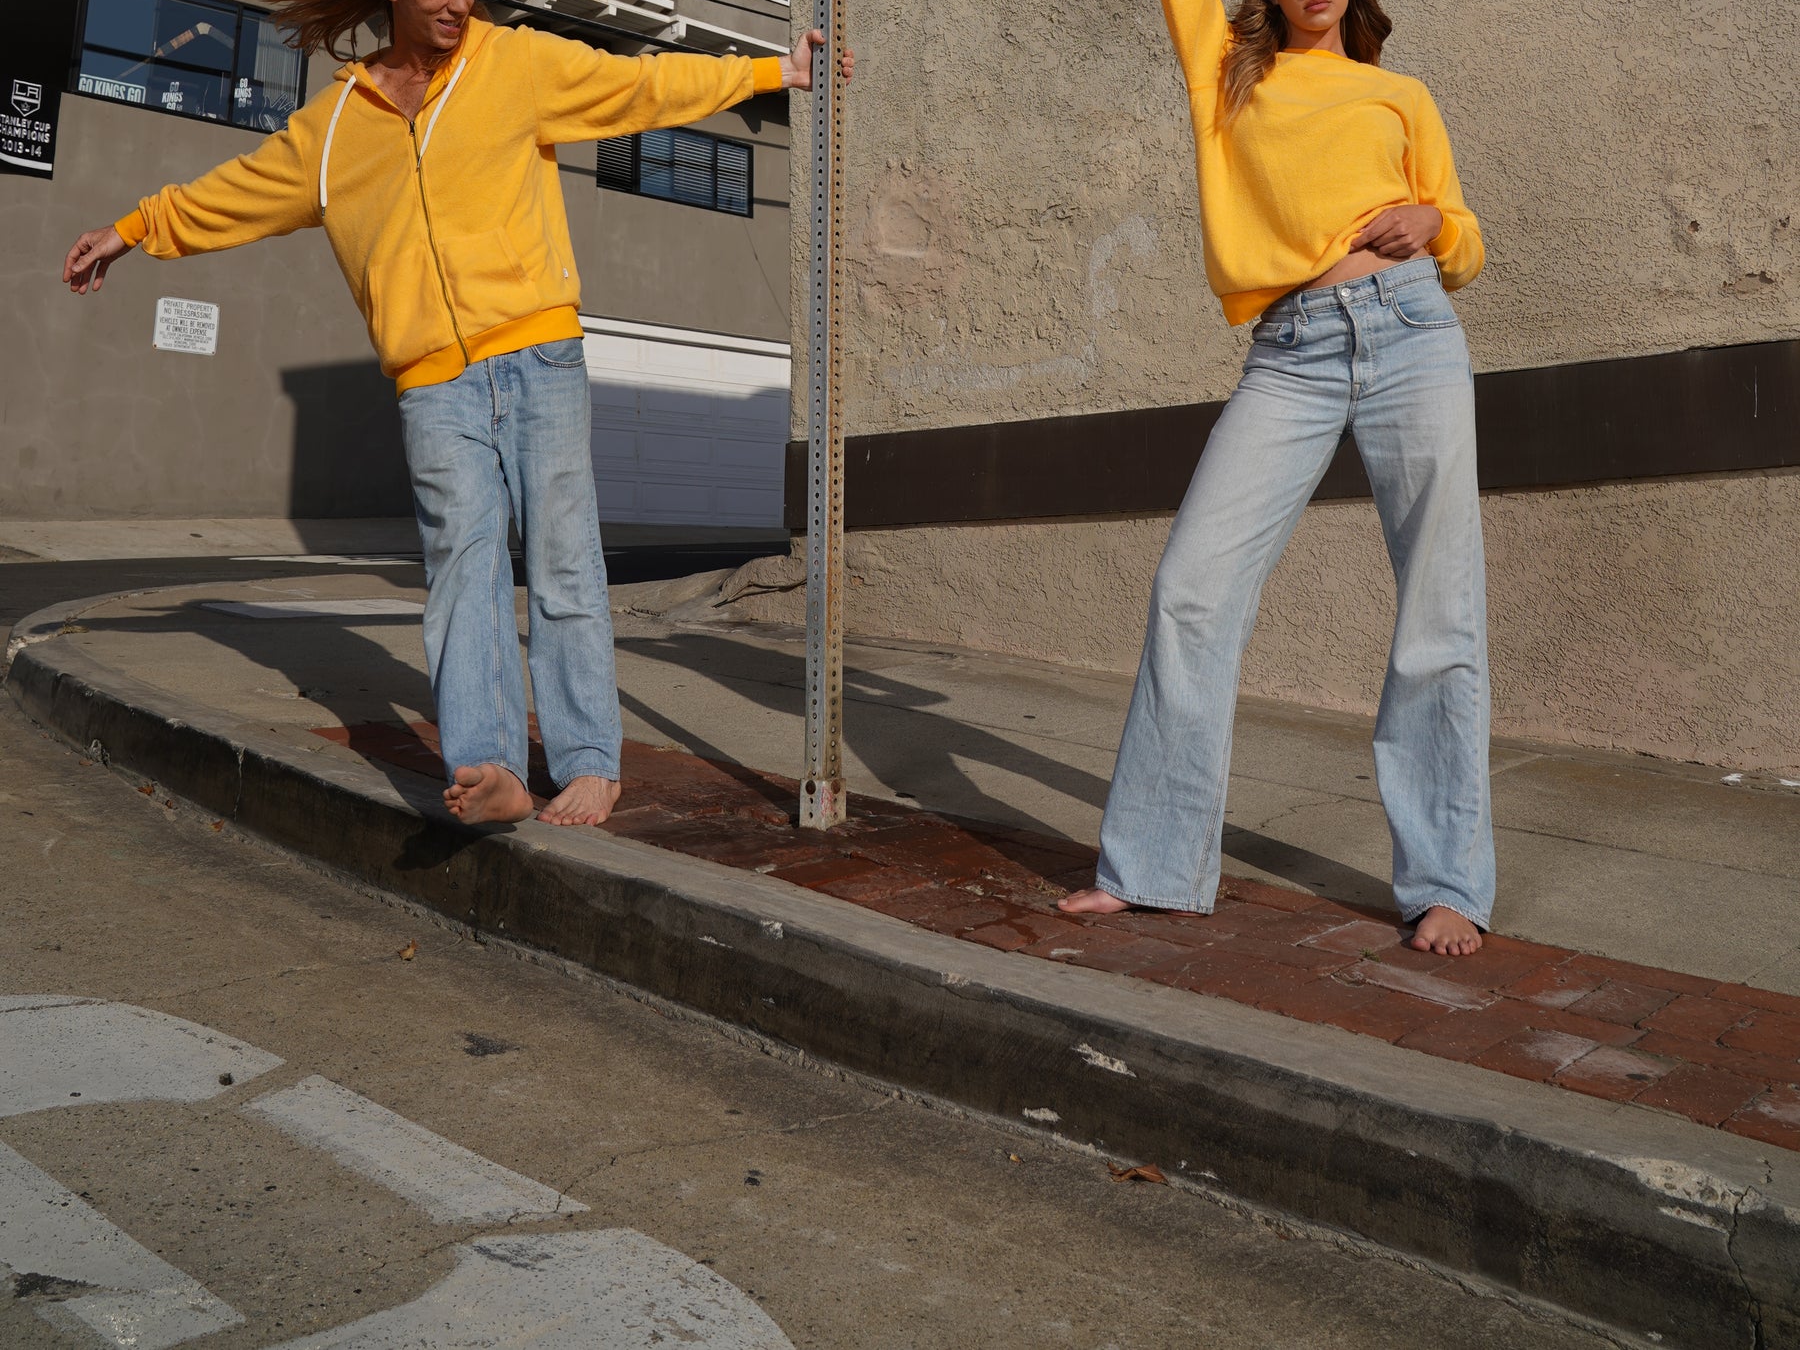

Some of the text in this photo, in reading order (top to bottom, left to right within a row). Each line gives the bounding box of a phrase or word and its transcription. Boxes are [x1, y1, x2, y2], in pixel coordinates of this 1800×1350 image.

[169, 81, 180, 91] GO
[240, 78, 248, 88] GO
[15, 83, 39, 99] LA
[78, 77, 142, 103] GO KINGS GO
[234, 87, 252, 98] KINGS
[161, 91, 184, 103] KINGS
[0, 113, 51, 133] TANLEY CUP
[1, 137, 42, 158] 2013-14
[163, 299, 213, 312] PRIVATE PROPERTY
[160, 316, 178, 325] VEHICLES
[189, 327, 207, 336] EXPENSE
